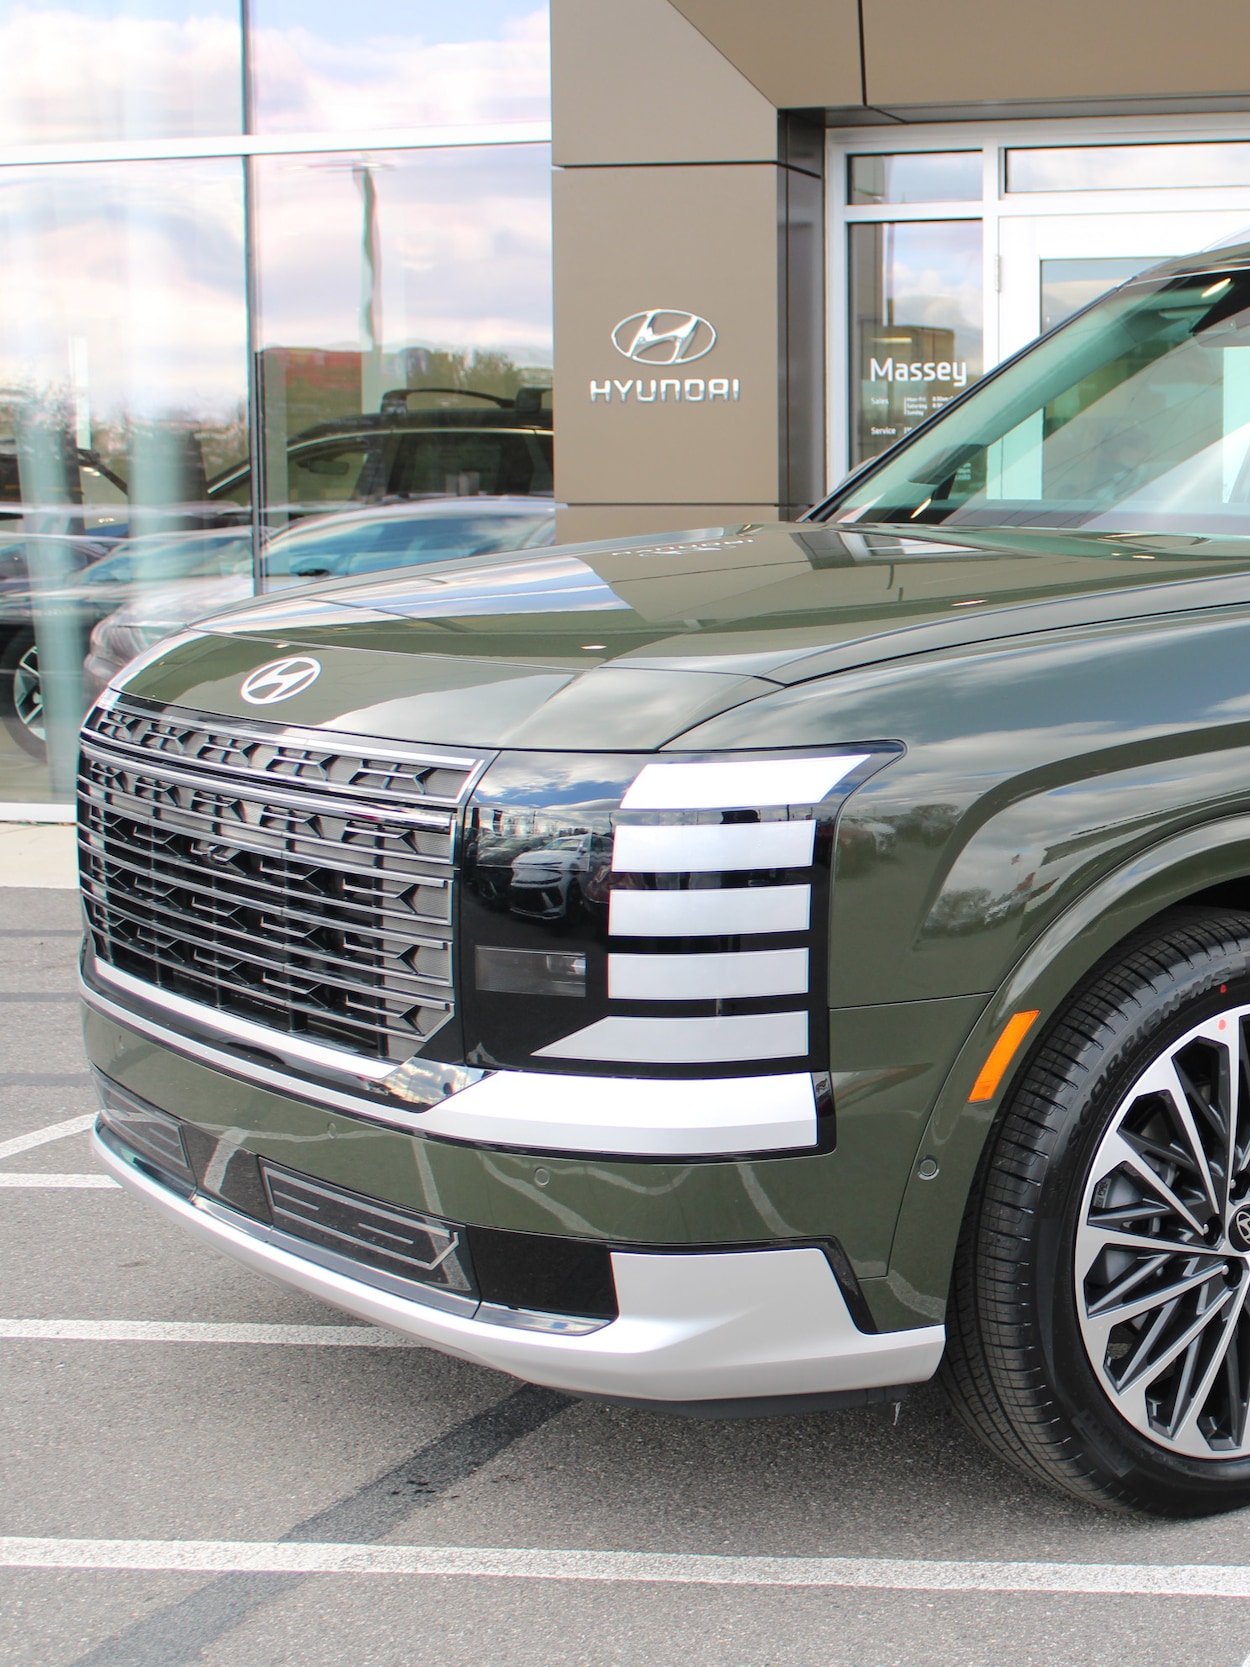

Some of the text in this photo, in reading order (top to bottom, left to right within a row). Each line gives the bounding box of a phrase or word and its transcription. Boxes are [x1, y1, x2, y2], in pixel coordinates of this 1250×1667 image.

[869, 357, 968, 387] Massey
[589, 378, 741, 403] HYUNDAI
[870, 427, 897, 435] Service
